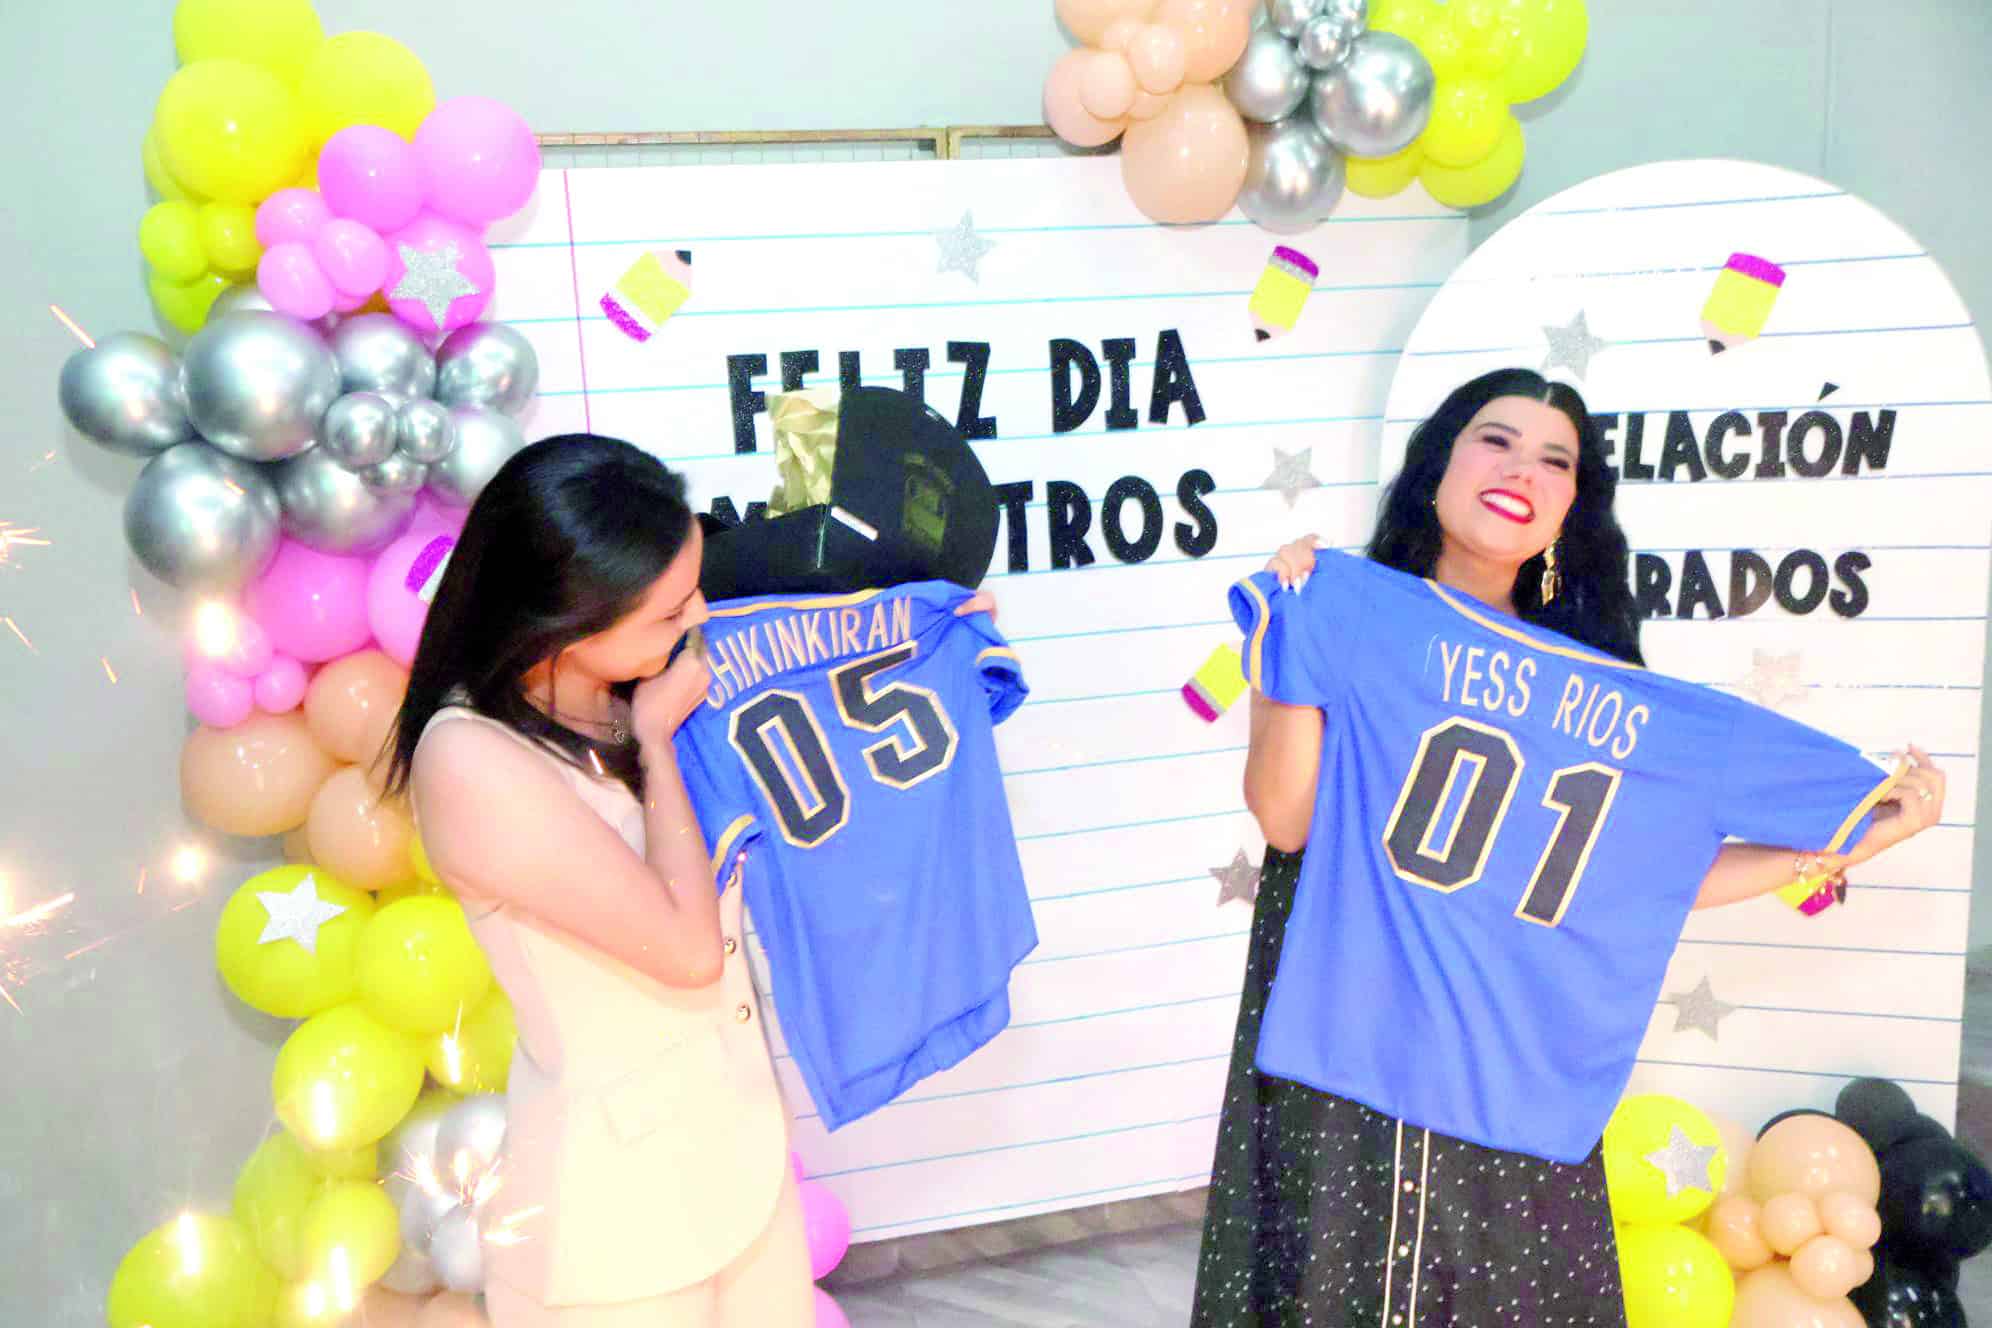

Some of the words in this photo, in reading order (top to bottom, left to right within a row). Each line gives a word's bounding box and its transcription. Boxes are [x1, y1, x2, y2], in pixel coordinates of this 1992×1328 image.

[1049, 328, 1206, 433] DIA
[1588, 382, 1897, 482] ELACIÓN
[1634, 548, 1872, 619] RADOS
[728, 640, 959, 848] 05
[1440, 641, 1537, 717] YESS
[1551, 673, 1650, 760] RIOS
[1381, 716, 1623, 928] 01
